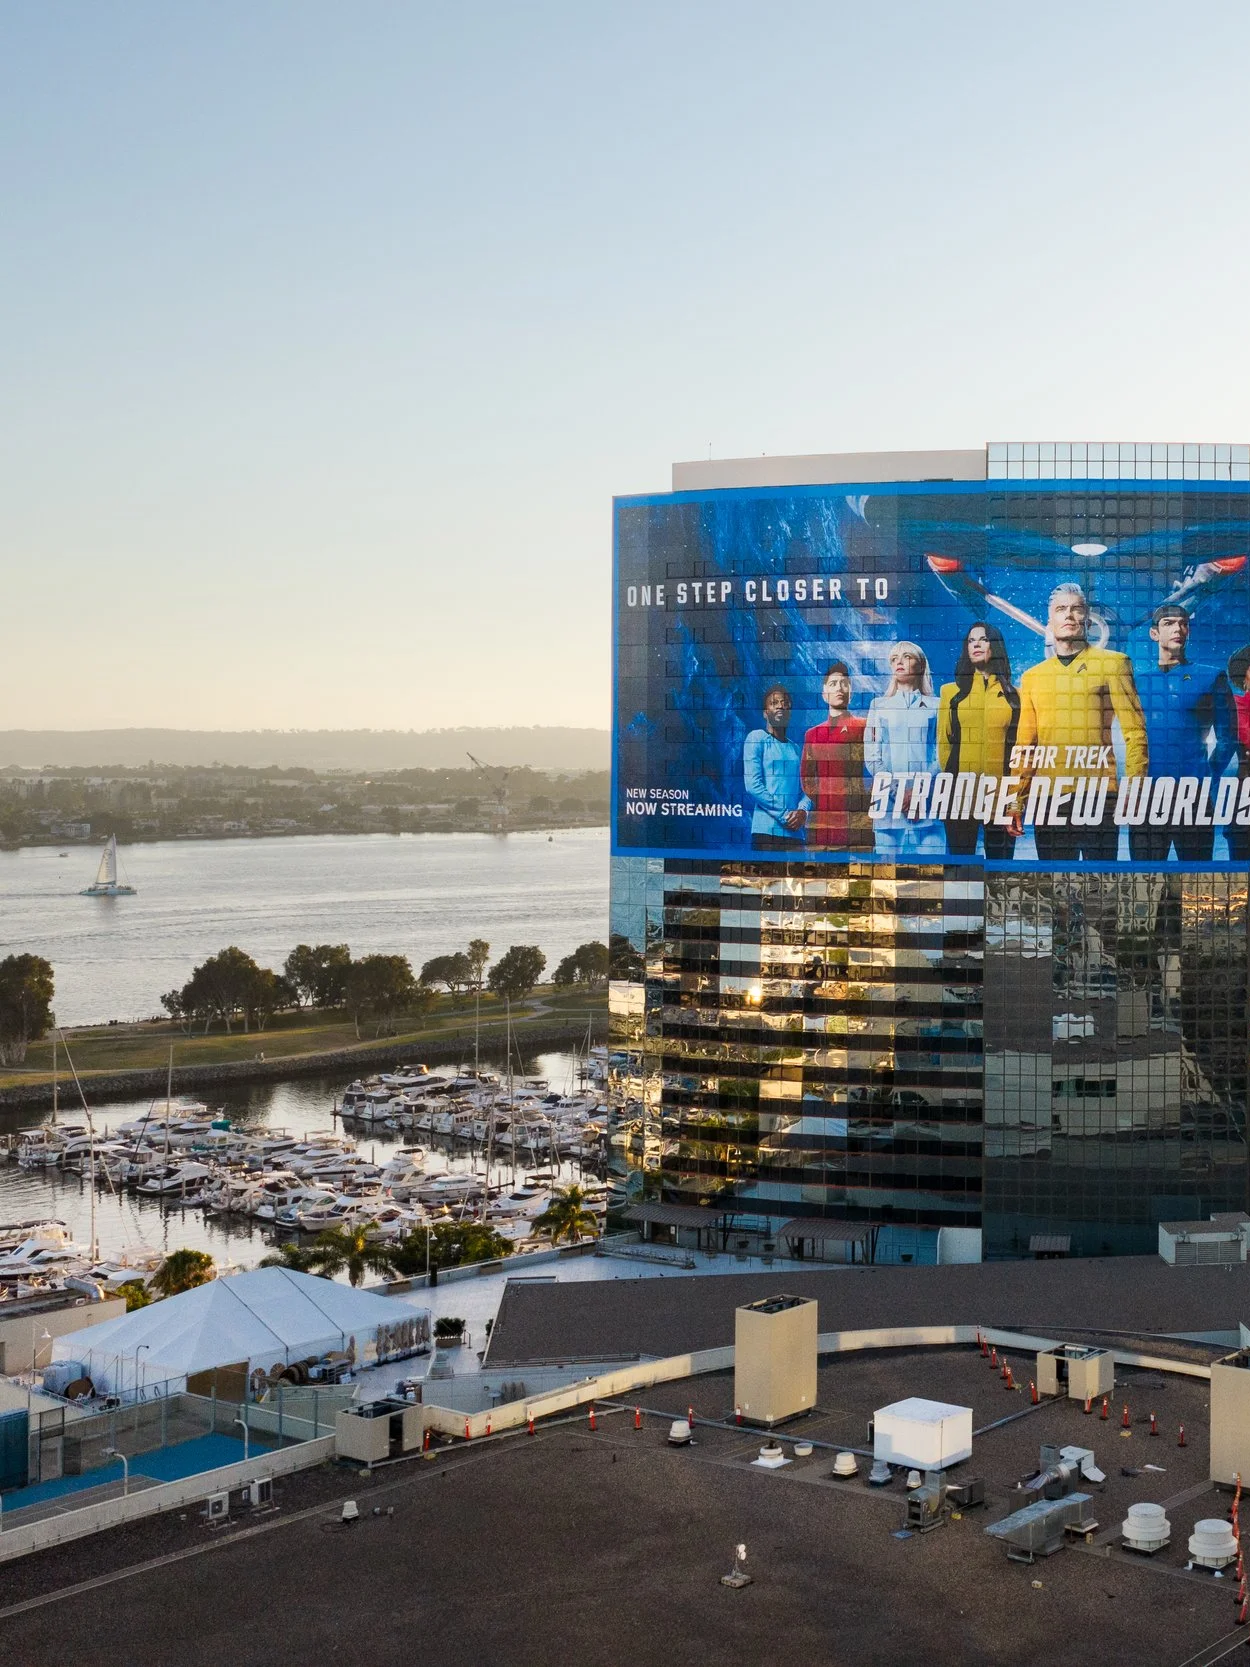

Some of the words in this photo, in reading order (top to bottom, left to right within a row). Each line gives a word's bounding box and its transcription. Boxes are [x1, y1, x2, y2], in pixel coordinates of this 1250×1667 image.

[627, 585, 666, 607] ONE
[676, 581, 733, 604] STEP
[745, 578, 842, 602] CLOSER
[856, 578, 889, 601] TO
[1008, 745, 1057, 769] STAR
[1063, 745, 1112, 769] TREK
[626, 788, 647, 799] NEW
[649, 789, 689, 800] SEASON
[868, 772, 1021, 826] STRANGE
[1024, 776, 1111, 826] NEW
[626, 802, 658, 815] NOW
[660, 803, 743, 817] STREAMING
